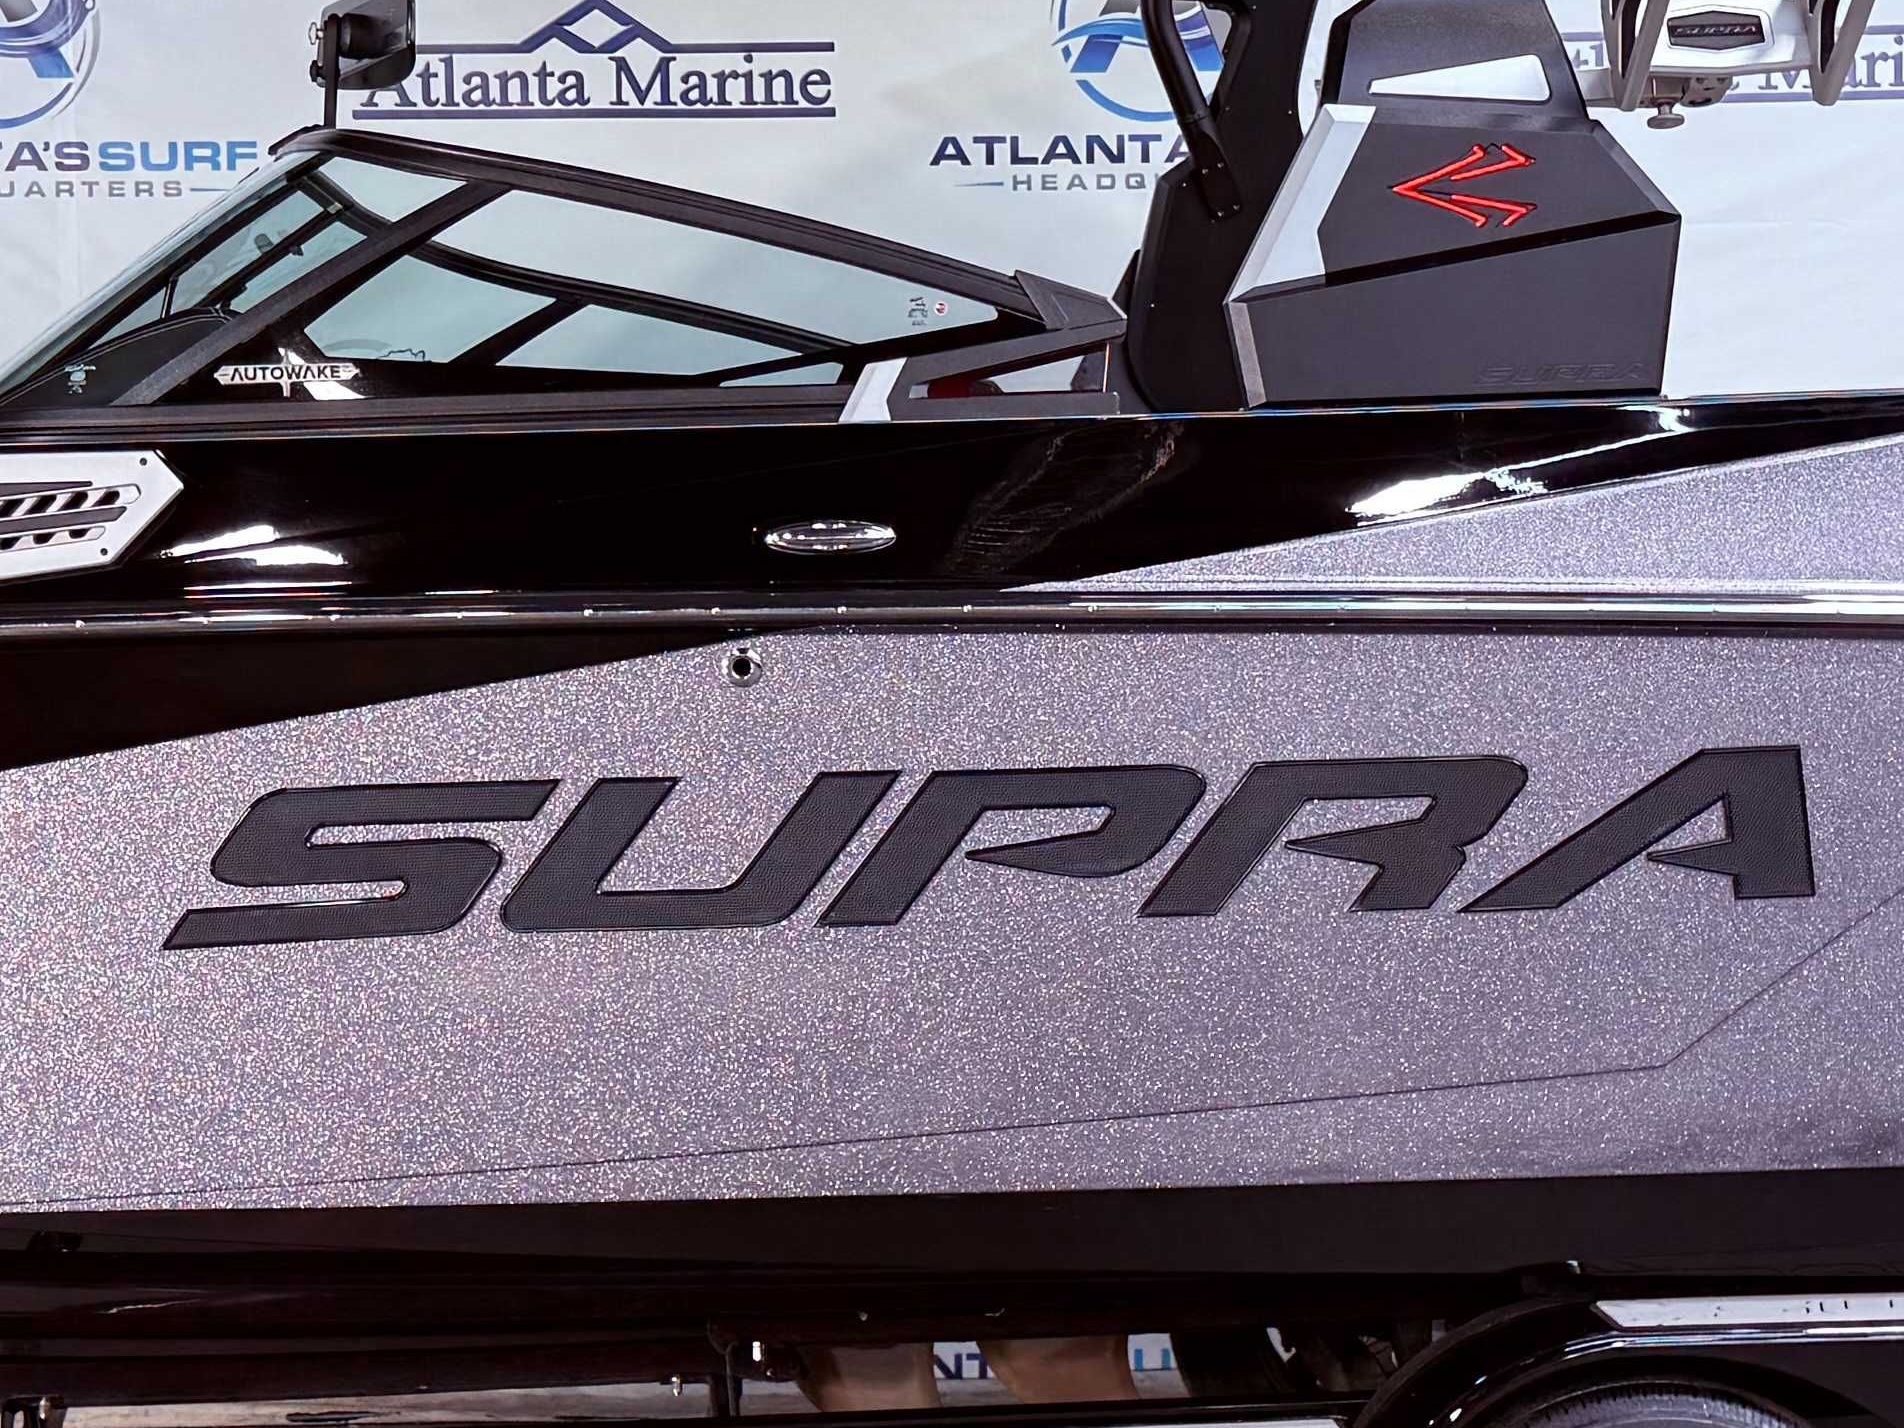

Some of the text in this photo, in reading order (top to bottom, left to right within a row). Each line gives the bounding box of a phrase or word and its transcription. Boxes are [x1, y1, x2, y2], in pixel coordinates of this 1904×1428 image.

[606, 49, 835, 109] Marine
[230, 364, 341, 382] AUTOWAKE
[163, 744, 1818, 950] SUPRA
